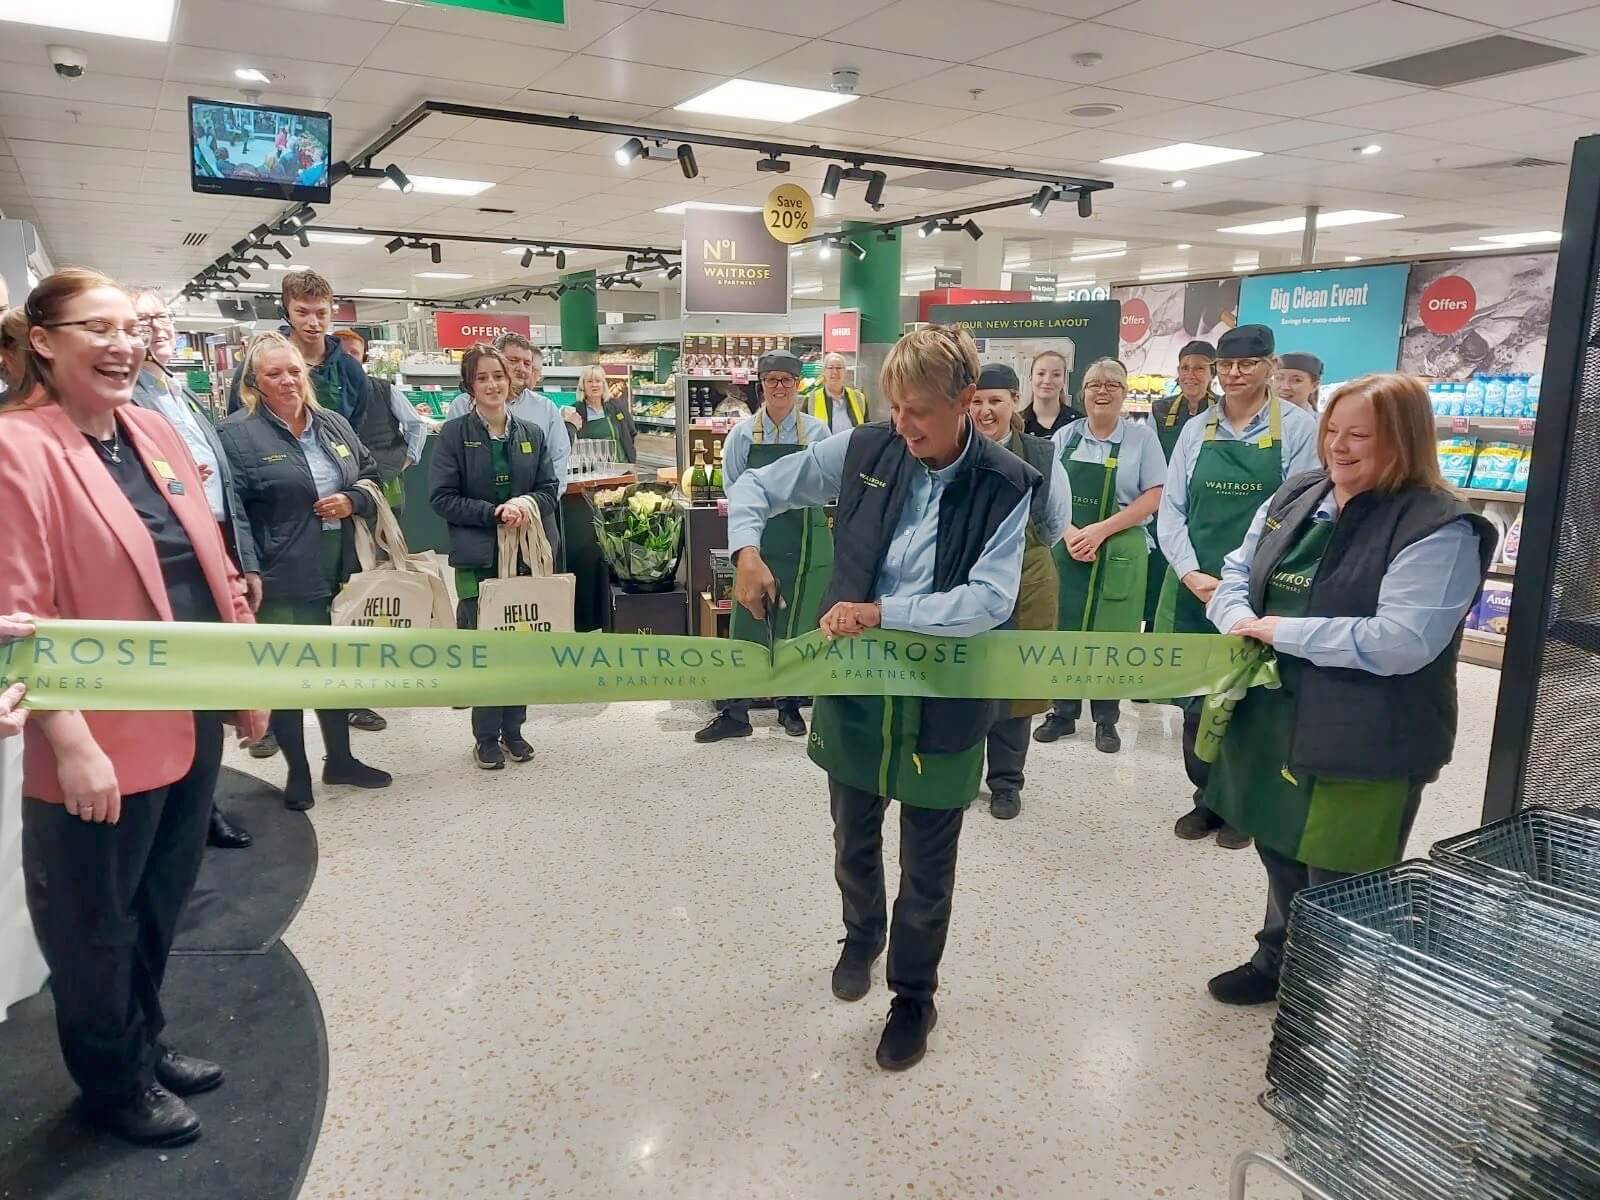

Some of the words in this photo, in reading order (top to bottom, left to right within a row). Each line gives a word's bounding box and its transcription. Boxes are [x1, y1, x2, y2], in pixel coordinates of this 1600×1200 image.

[777, 195, 803, 209] Save
[771, 210, 809, 230] 20%
[703, 267, 770, 279] WAITROSE
[1269, 288, 1290, 314] Big
[1292, 286, 1328, 309] Clean
[1330, 283, 1369, 307] Event
[1428, 299, 1468, 311] Offers
[957, 321, 982, 330] YOUR
[986, 320, 1009, 329] NEW
[1013, 319, 1044, 328] STORE
[1048, 318, 1089, 327] LAYOUT
[1121, 315, 1146, 326] Offers
[1205, 481, 1264, 491] WAITROSE
[363, 597, 400, 617] HELLO
[503, 603, 538, 624] HELLO
[247, 642, 488, 668] WAITROSE
[551, 646, 746, 668] WAITROSE
[795, 638, 968, 664] WAITROSE
[1018, 645, 1184, 667] WAITROSE
[598, 676, 606, 687] &
[616, 676, 707, 687] PARTNERS
[831, 669, 837, 679] &
[846, 669, 927, 681] PARTNERS
[1051, 676, 1057, 684] &
[1066, 675, 1144, 684] PARTNERS
[302, 679, 311, 689] &
[324, 678, 440, 689] PARTNERS
